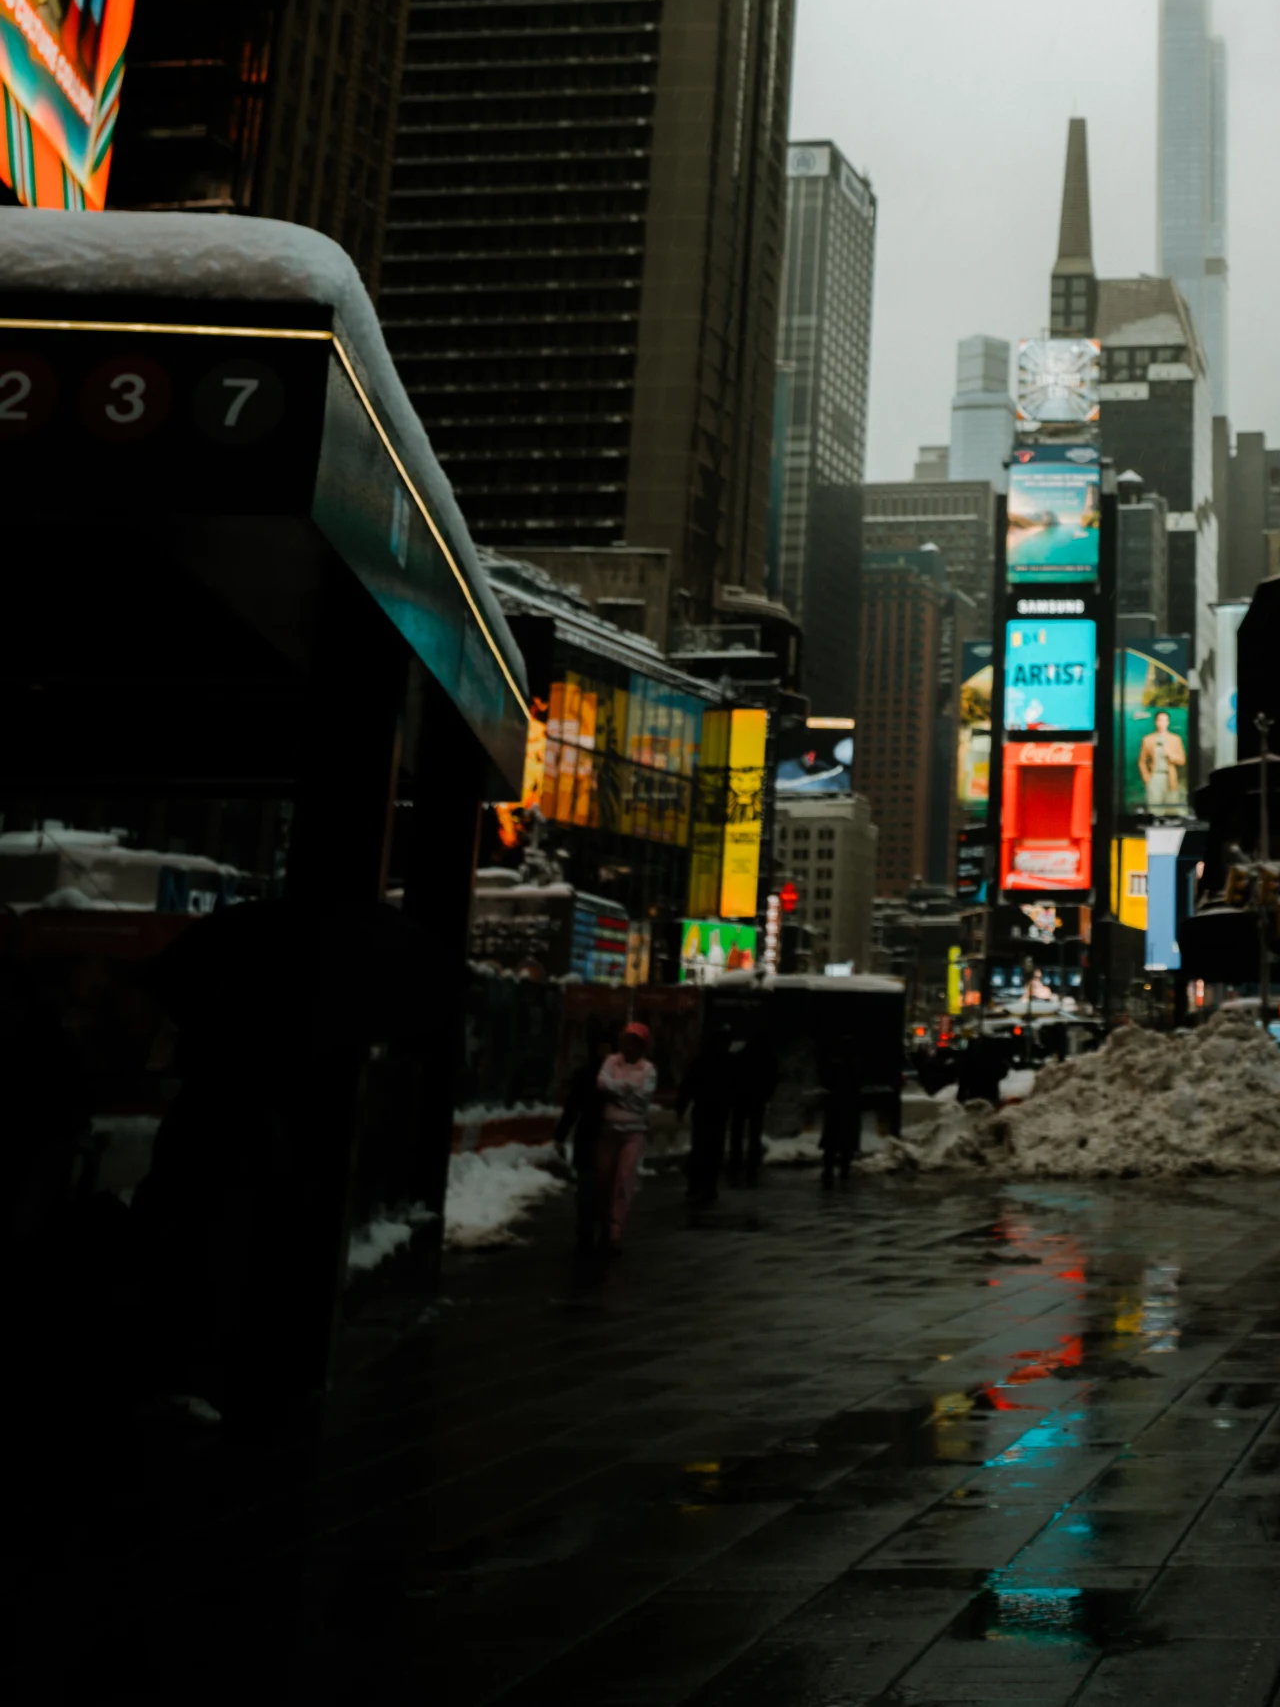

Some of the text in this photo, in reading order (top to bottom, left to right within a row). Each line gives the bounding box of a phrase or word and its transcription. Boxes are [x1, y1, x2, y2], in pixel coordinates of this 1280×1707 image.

[0, 369, 33, 421] 2
[104, 372, 147, 425] 3
[222, 377, 260, 427] 7
[1017, 598, 1085, 615] SAMSUNG
[1013, 661, 1088, 687] ARTIST
